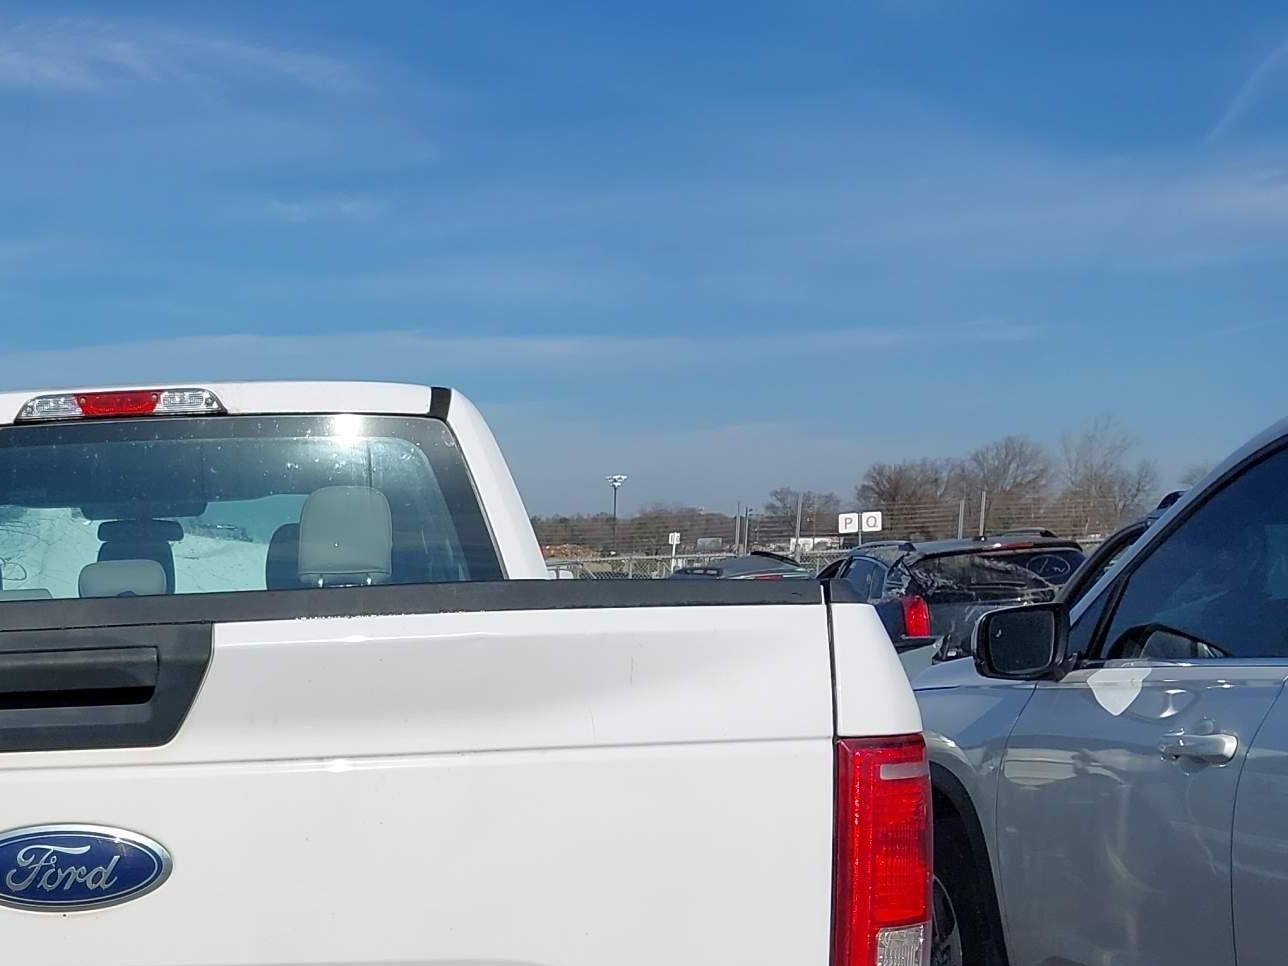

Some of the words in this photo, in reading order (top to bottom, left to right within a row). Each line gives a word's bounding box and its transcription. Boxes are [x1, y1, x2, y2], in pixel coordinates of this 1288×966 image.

[844, 517, 853, 530] P
[866, 515, 880, 528] Q
[6, 844, 120, 893] Ford
